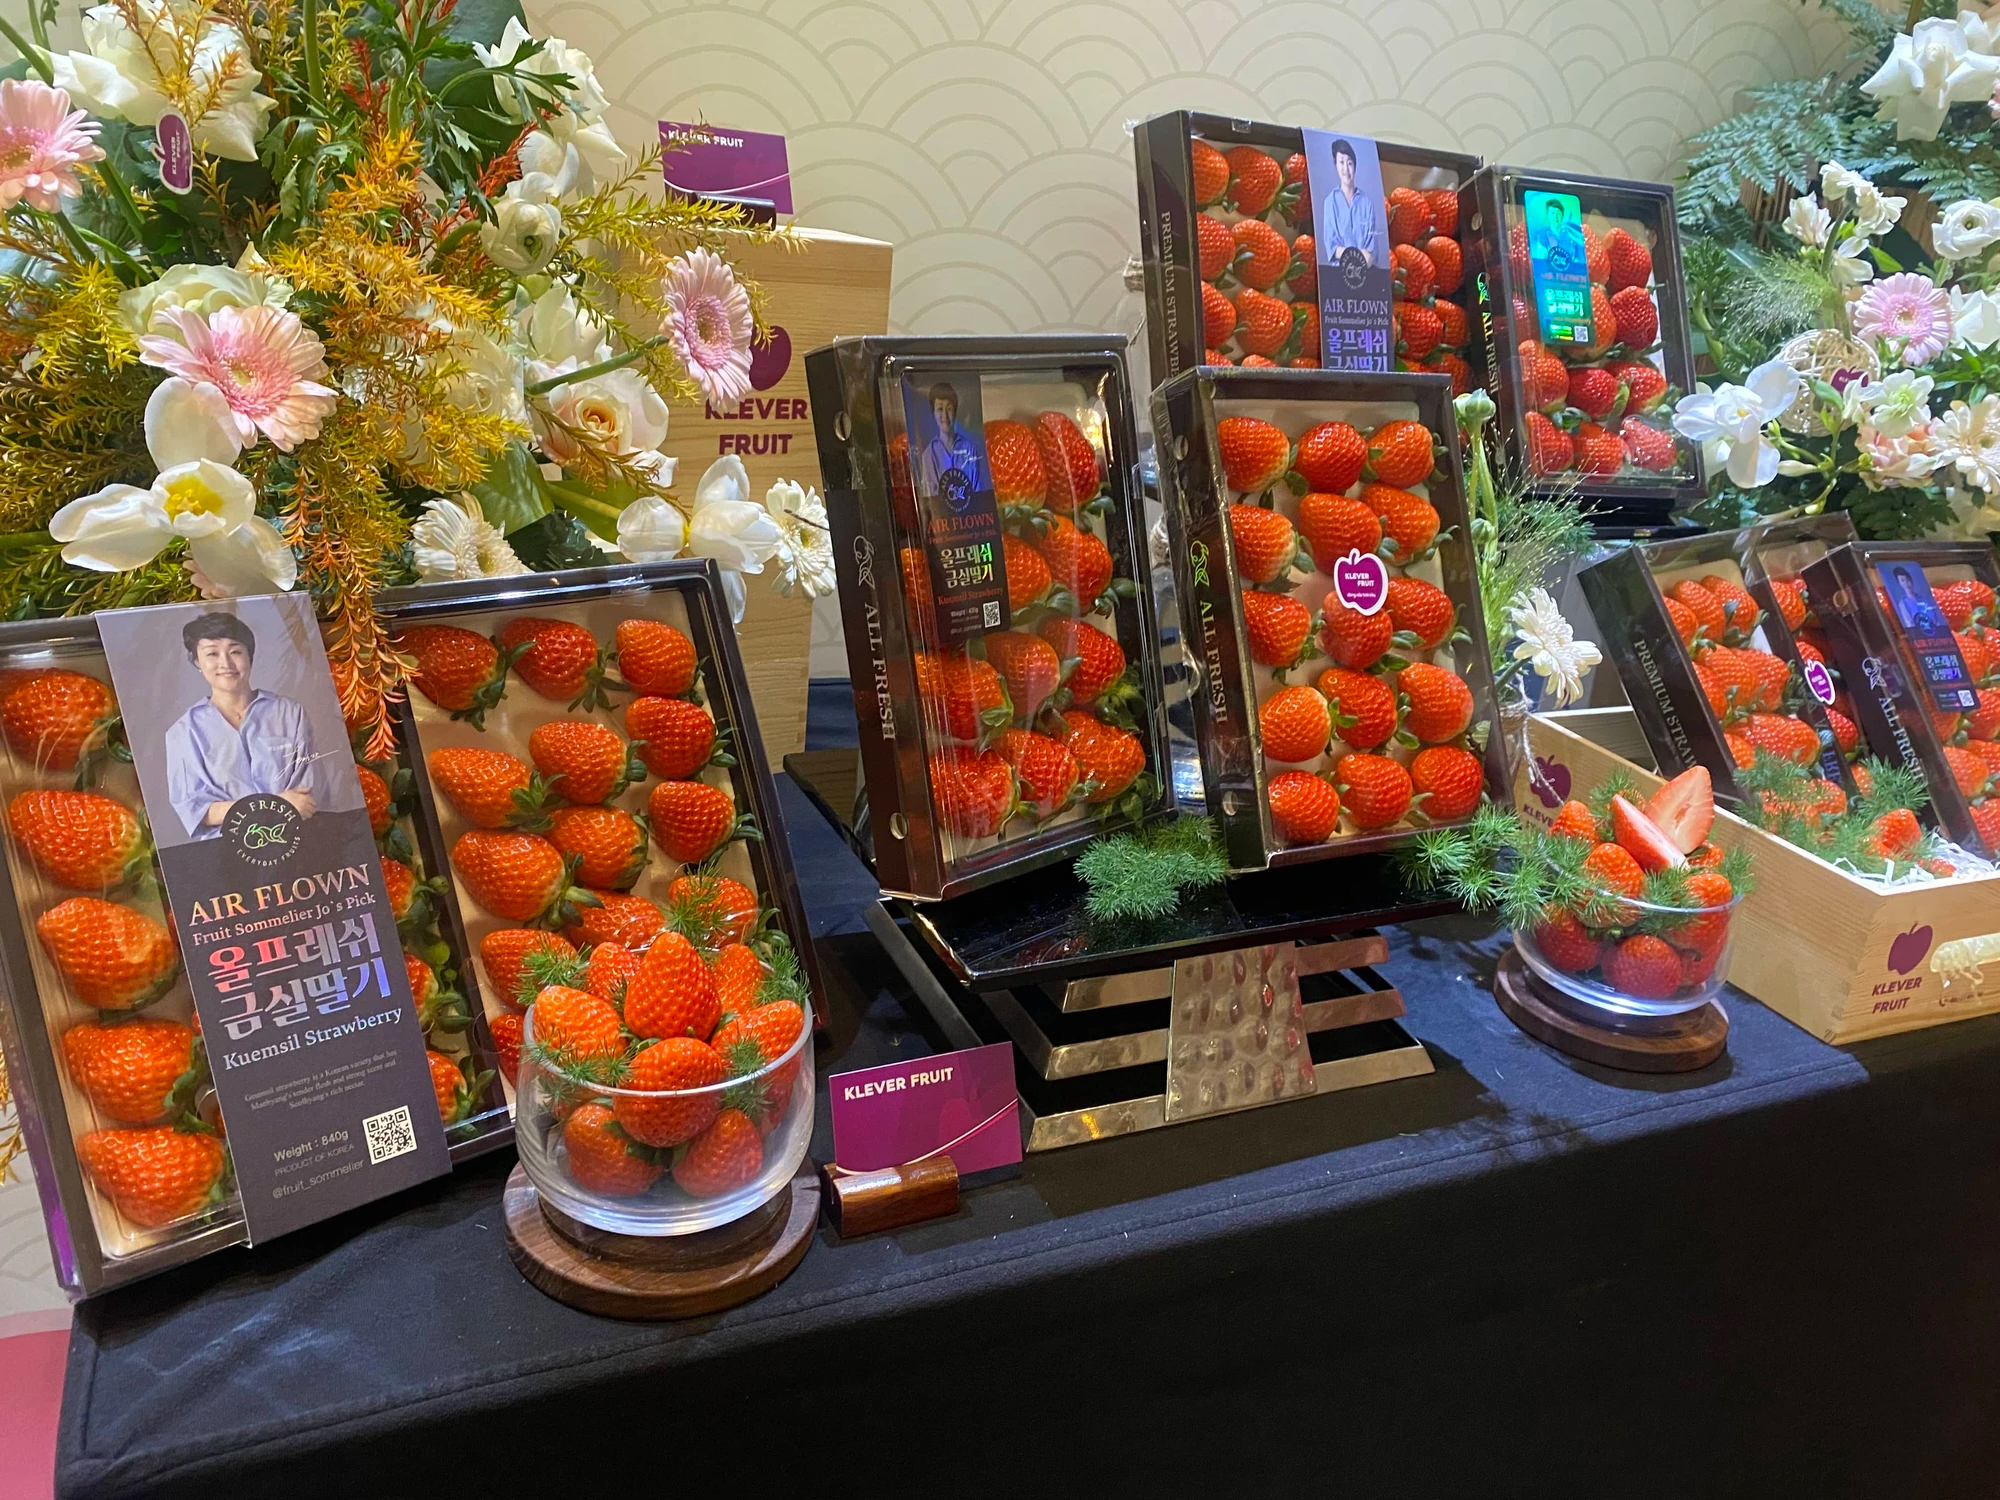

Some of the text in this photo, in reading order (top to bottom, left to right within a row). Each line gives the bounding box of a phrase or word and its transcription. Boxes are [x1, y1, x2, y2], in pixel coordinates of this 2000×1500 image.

[713, 135, 744, 148] FRUIT
[1161, 210, 1180, 378] PREMIUM STRAWBE
[1324, 299, 1389, 315] AIR FLOWN
[1327, 328, 1388, 354] 올프레쉬
[1482, 311, 1500, 395] ALL FRESH
[719, 433, 793, 455] FRUIT
[928, 512, 995, 535] AIR FLOWN
[941, 542, 993, 569] 올프레쉬
[946, 563, 994, 589] 금실딸기
[1344, 572, 1370, 580] KLEVER
[865, 602, 897, 741] ALL FRESH
[1200, 599, 1228, 723] ALL FRESH
[1634, 639, 1698, 769] PREMIUM STRAW
[1879, 697, 1925, 782] ALL FRESH
[228, 799, 297, 836] ALL FRESH
[1523, 803, 1556, 828] KLEVE
[236, 835, 301, 867] EVERYDAY FRUITS
[188, 863, 370, 927] AIR FLOWN
[192, 926, 232, 946] Fruit
[234, 908, 314, 936] Sommelier
[346, 891, 376, 910] Pick
[207, 911, 381, 994] 올프레쉬
[218, 956, 392, 1041] 금실딸기
[1871, 976, 1923, 997] KLEVER
[1872, 996, 1911, 1015] FRUIT
[222, 1007, 402, 1071] Kuemsil Strawberry
[324, 1064, 350, 1077] Korean
[349, 1057, 372, 1069] variety
[372, 1052, 385, 1062] that
[844, 1067, 954, 1101] KLEVER FRUIT
[273, 1141, 313, 1163] Weight
[321, 1130, 349, 1146] 840g
[274, 1143, 355, 1177] PRODUCT OF KOREA
[272, 1159, 365, 1199] @fruit_sommelier
